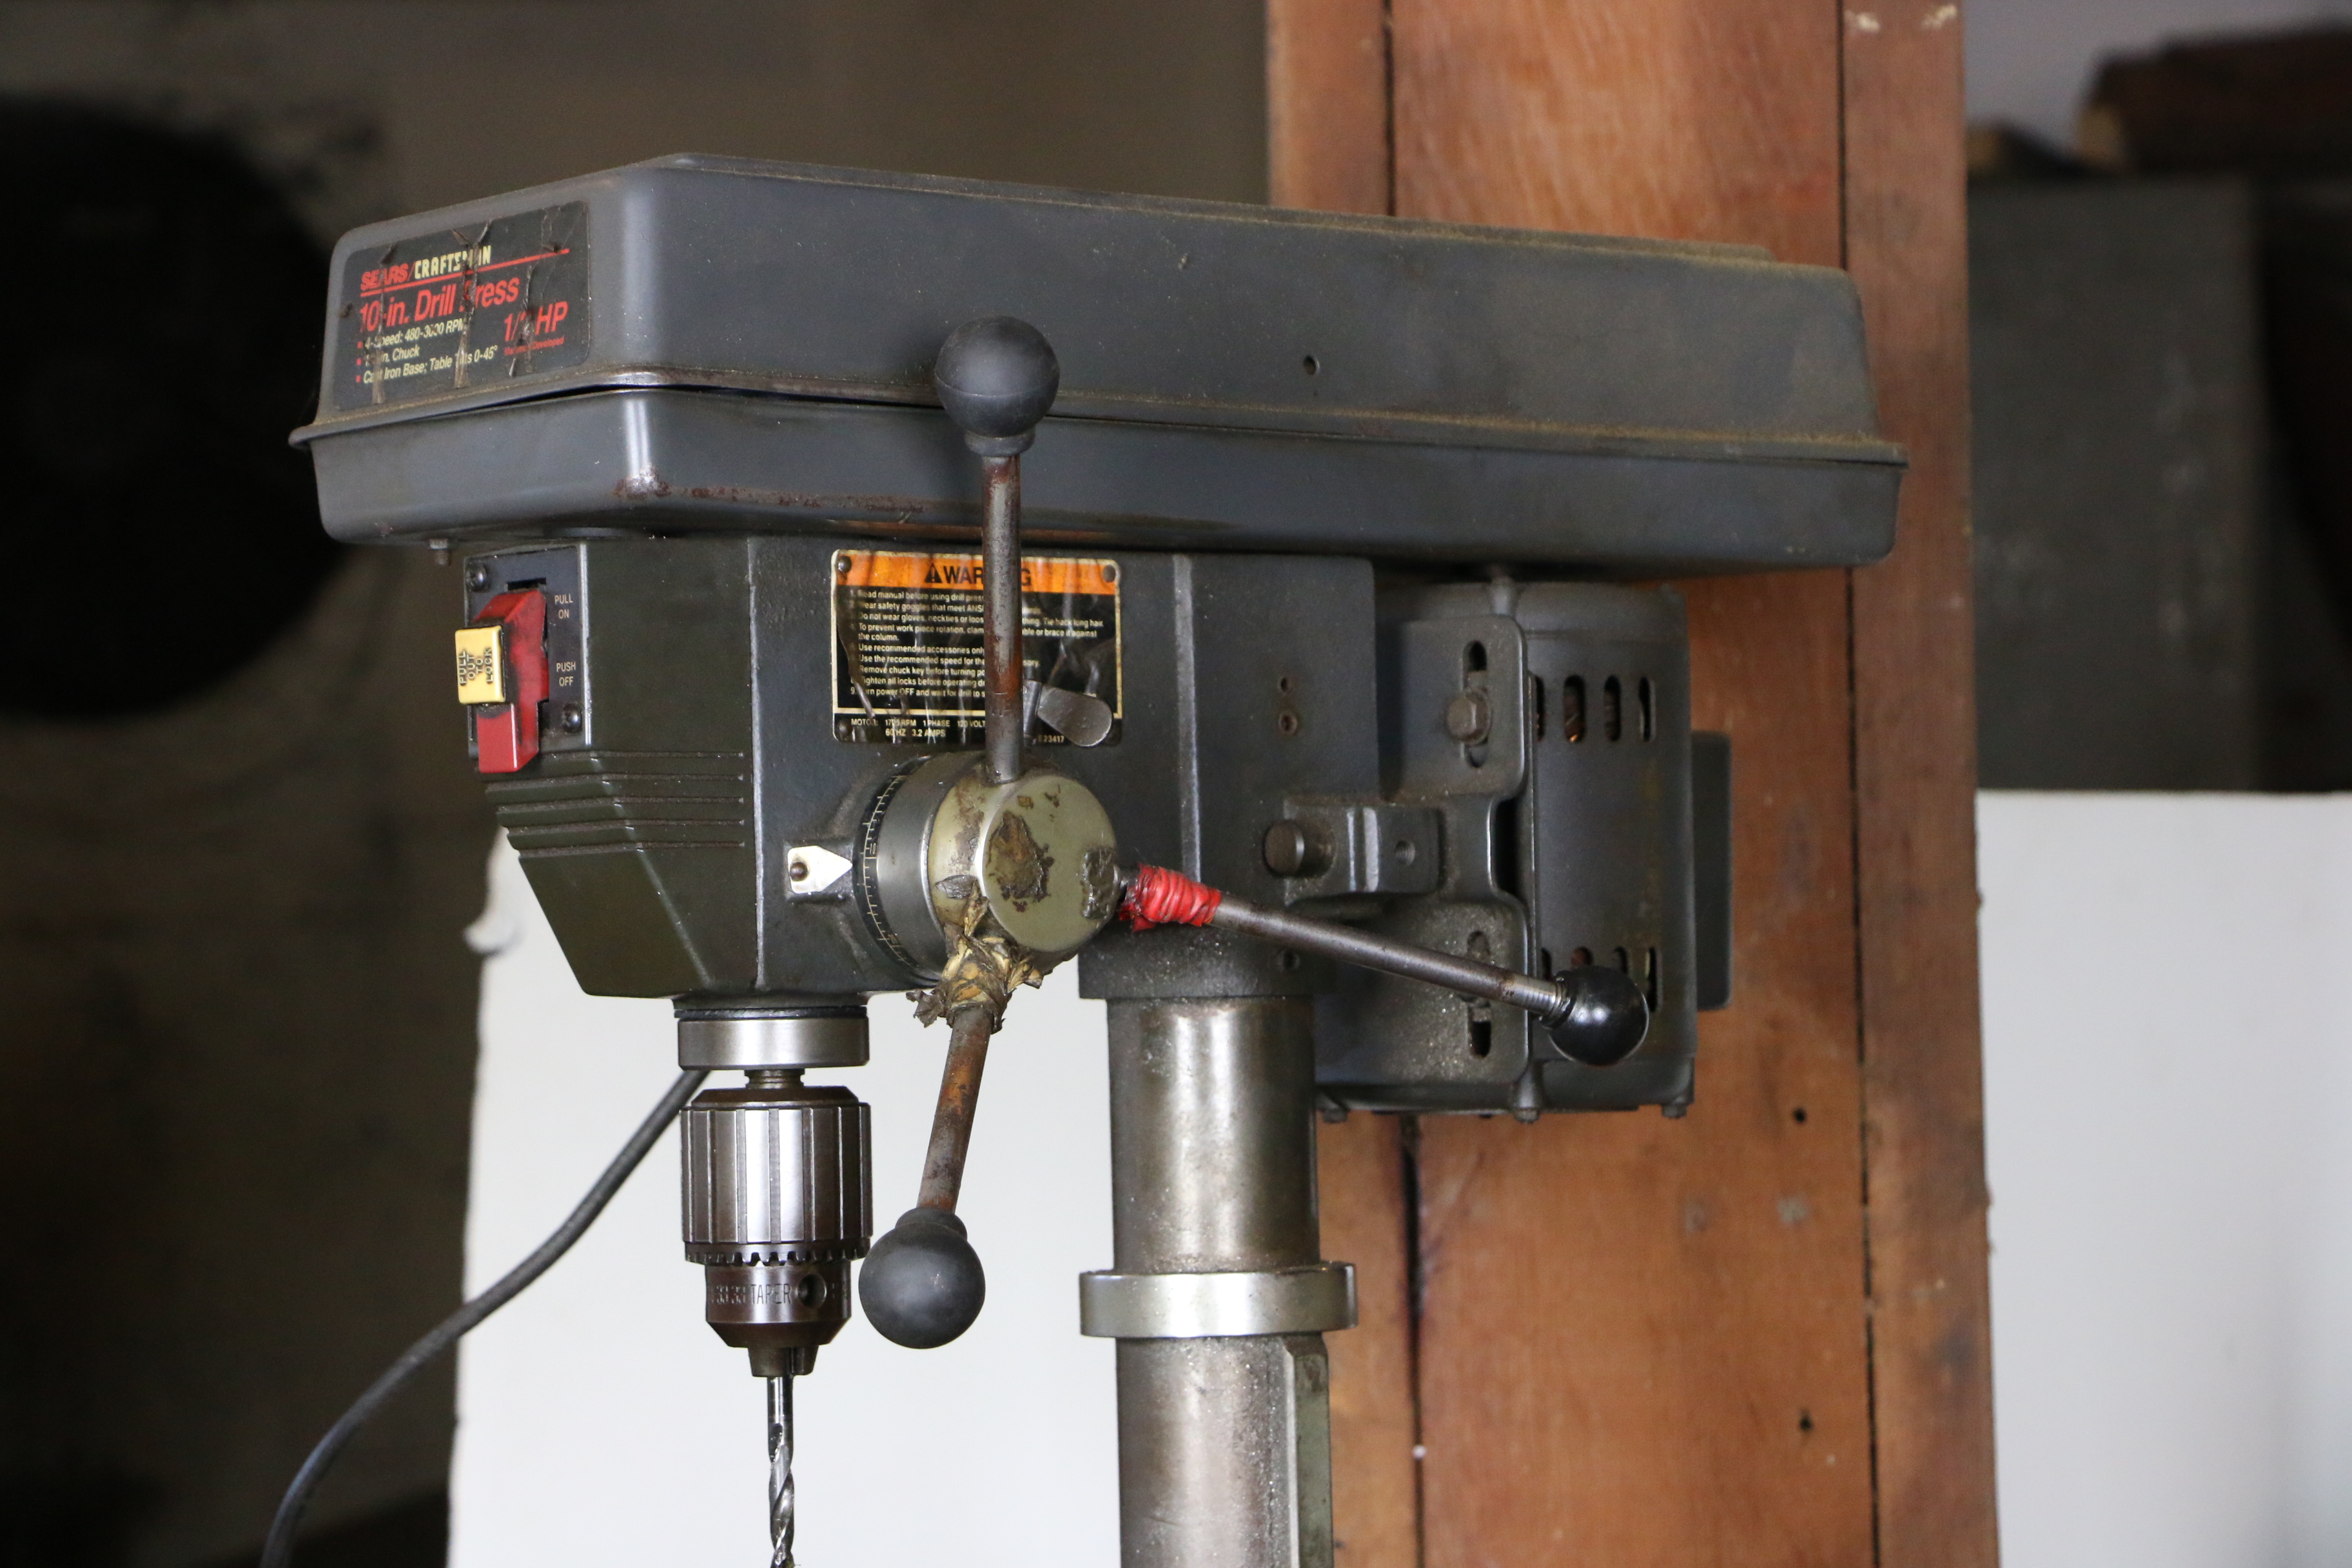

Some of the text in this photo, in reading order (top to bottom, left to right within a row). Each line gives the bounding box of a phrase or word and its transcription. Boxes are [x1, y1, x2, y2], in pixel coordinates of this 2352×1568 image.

[414, 284, 456, 322] Drill
[504, 300, 569, 342] 1/ HP
[393, 344, 420, 361] Chuck
[364, 369, 383, 384] Cat
[384, 366, 401, 380] Iron
[429, 355, 453, 371] Table
[474, 344, 498, 363] 0-45°
[943, 565, 1032, 586] WARG
[554, 594, 573, 604] PULL
[905, 591, 928, 600] before
[930, 593, 950, 602] using
[877, 602, 900, 611] safety
[901, 603, 930, 612] goggles
[558, 609, 569, 619] ON
[928, 614, 959, 623] neckties
[968, 615, 984, 623] loos
[1055, 618, 1072, 626] back
[1073, 619, 1088, 629] long
[868, 624, 895, 632] prevent
[915, 625, 934, 634] piece
[1044, 628, 1064, 636] brace
[1066, 629, 1072, 637] it
[1072, 629, 1097, 640] against
[871, 632, 899, 641] column.
[874, 644, 926, 653] recommended
[467, 654, 475, 680] OUT
[476, 658, 484, 674] TO
[484, 647, 493, 684] LOCK
[556, 661, 576, 672] PUSH
[859, 654, 873, 663] Use
[874, 654, 886, 663] the
[887, 655, 939, 664] recommended
[940, 657, 963, 667] speed
[458, 651, 467, 685] PULL
[859, 665, 888, 674] Remove
[889, 666, 911, 674] chuck
[912, 667, 925, 676] key
[926, 667, 949, 676] before
[950, 668, 975, 677] turning
[559, 676, 574, 686] OFF
[863, 676, 886, 685] ighten
[897, 677, 916, 685] locks
[943, 679, 977, 689] operating
[959, 689, 972, 697] drill
[885, 728, 894, 736] 60
[912, 729, 923, 737] 3.2
[751, 1284, 793, 1304] TAPER
